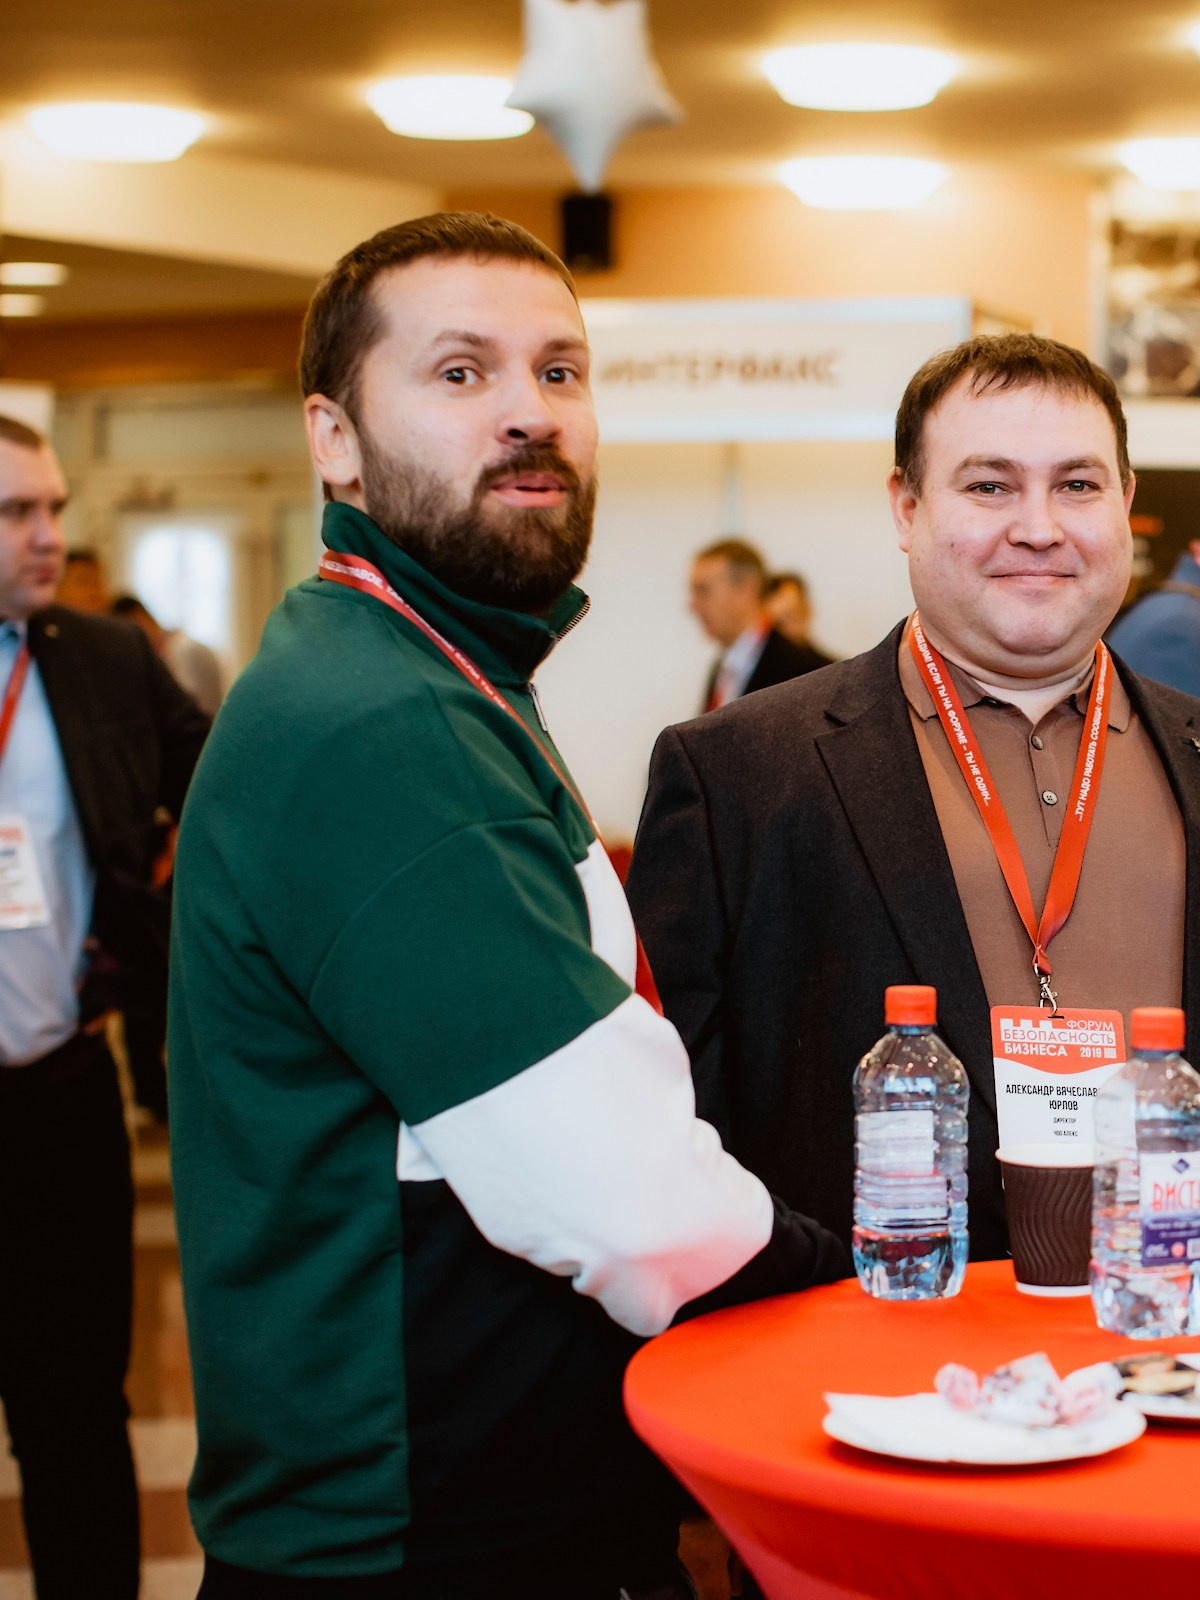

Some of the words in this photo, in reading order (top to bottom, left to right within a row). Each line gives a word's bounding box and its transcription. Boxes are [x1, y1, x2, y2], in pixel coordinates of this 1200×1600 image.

[926, 661, 943, 684] ЕСЛИ
[937, 684, 948, 697] ТЫ
[942, 696, 953, 710] НА
[947, 709, 968, 744] ФОРУМЕ
[964, 750, 976, 764] ТЫ
[1083, 740, 1097, 777] РАБОТАТЬ
[969, 763, 981, 776] НЕ
[1078, 776, 1091, 801] НАДО
[1066, 1019, 1115, 1032] ФОРУМ
[1004, 1029, 1115, 1044] БЕЗОПАСНОСТЬ
[1004, 1043, 1068, 1057] БИЗНЕСА
[1080, 1047, 1102, 1058] 2019
[1005, 1084, 1054, 1096] АЛЕКСАНДР
[1056, 1086, 1099, 1097] ВЯЧЕСЛАВ
[1049, 1100, 1079, 1111] ЮРЛОВ
